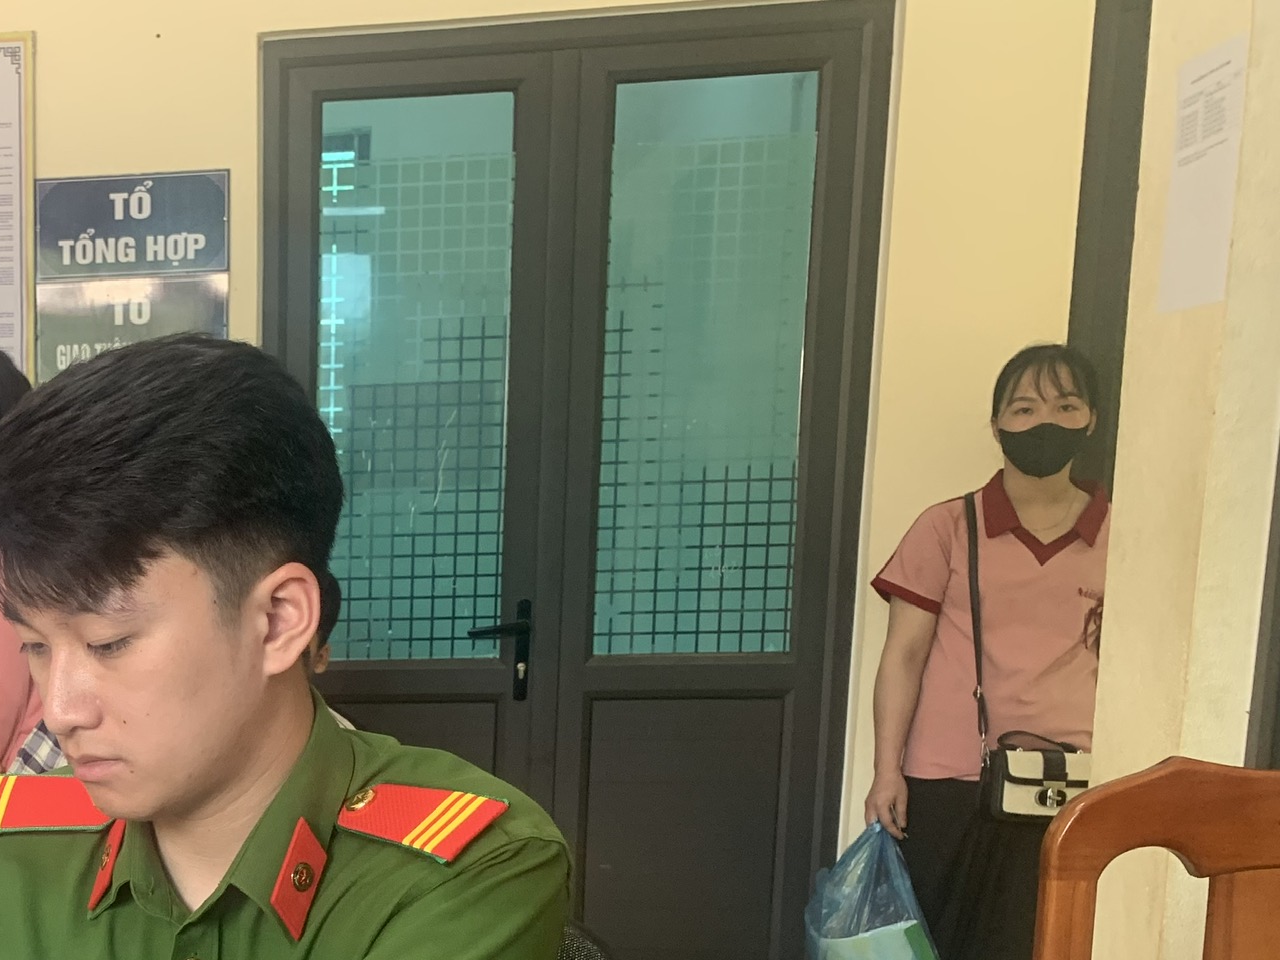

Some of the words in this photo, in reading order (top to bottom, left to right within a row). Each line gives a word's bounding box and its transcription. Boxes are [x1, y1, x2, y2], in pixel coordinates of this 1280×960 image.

[109, 180, 153, 220] TỔ
[58, 228, 136, 266] TỔNG
[146, 232, 206, 266] HỢP
